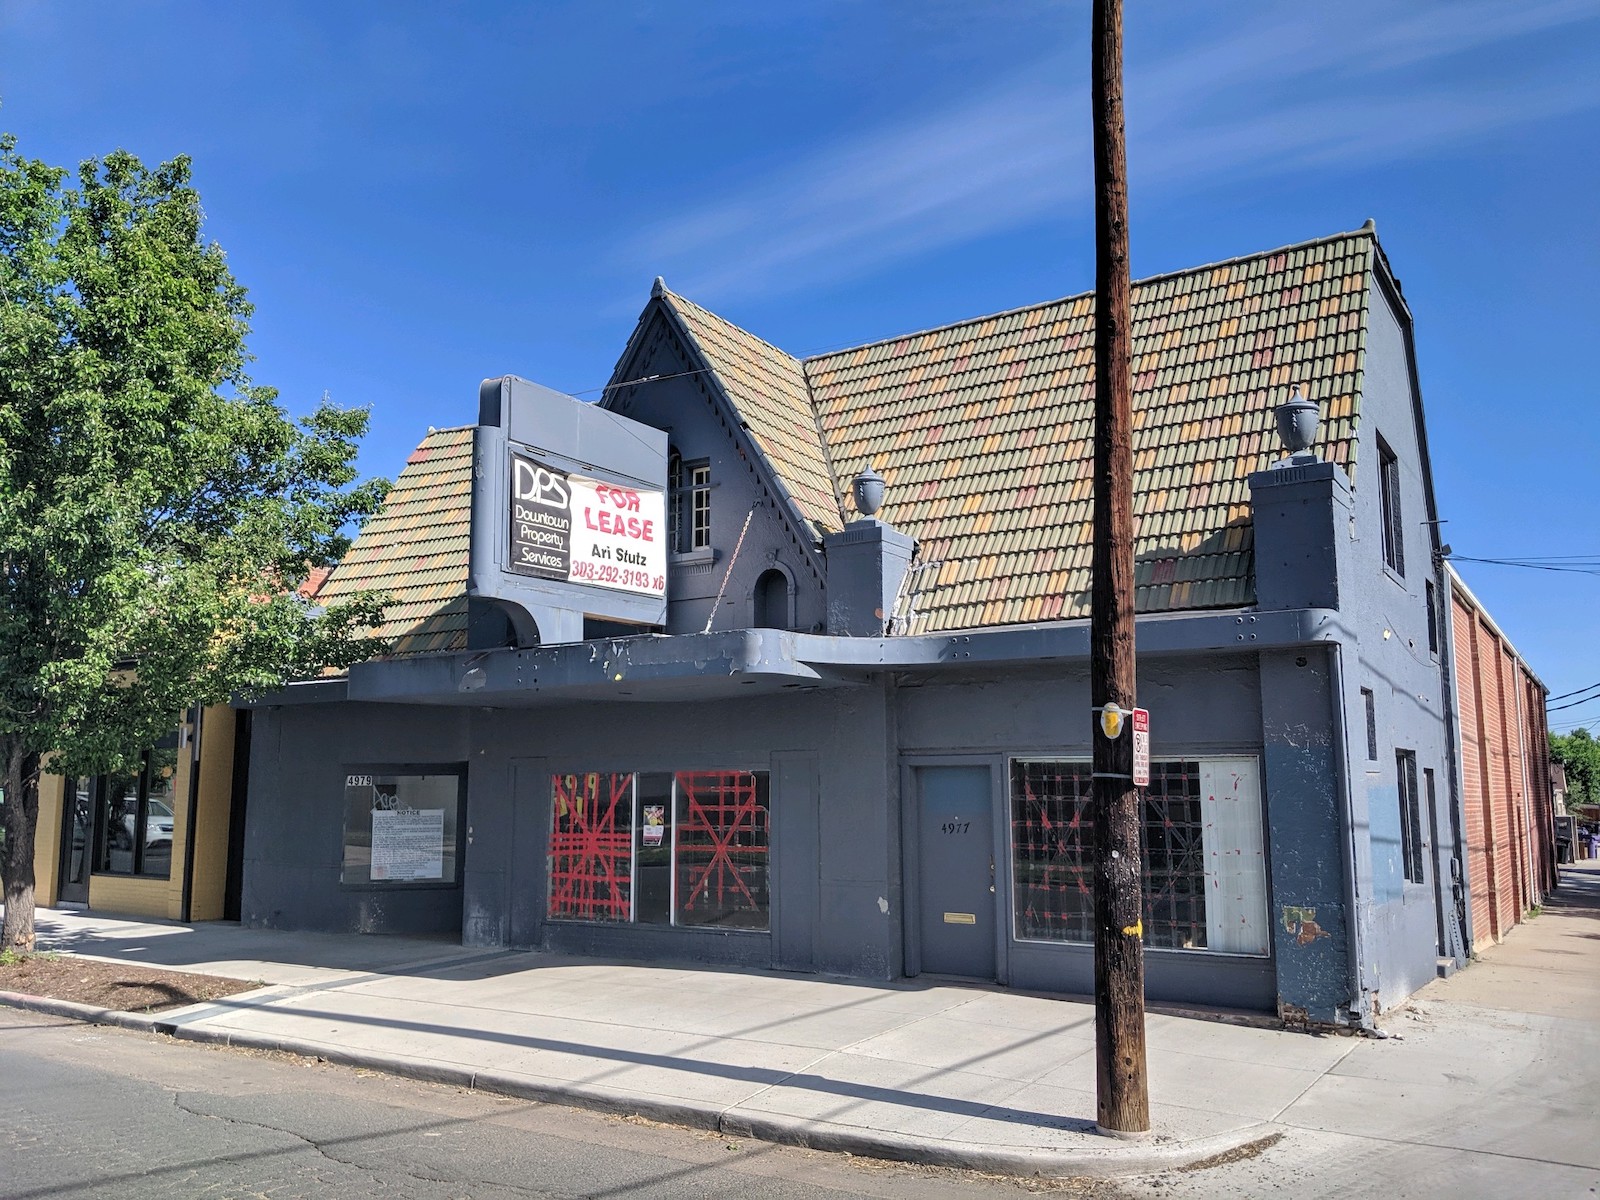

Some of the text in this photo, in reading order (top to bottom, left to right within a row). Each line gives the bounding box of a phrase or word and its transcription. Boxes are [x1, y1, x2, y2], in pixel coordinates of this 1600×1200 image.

[514, 459, 569, 509] DPS
[595, 485, 641, 512] FOR
[515, 505, 569, 529] Downtown
[584, 507, 654, 542] LEASE
[521, 525, 563, 550] Property
[521, 547, 562, 567] Services
[591, 544, 647, 566] Ari Stutz
[572, 560, 665, 590] 303-292-3193 x6
[348, 776, 372, 786] 4979
[941, 822, 970, 834] 4977
